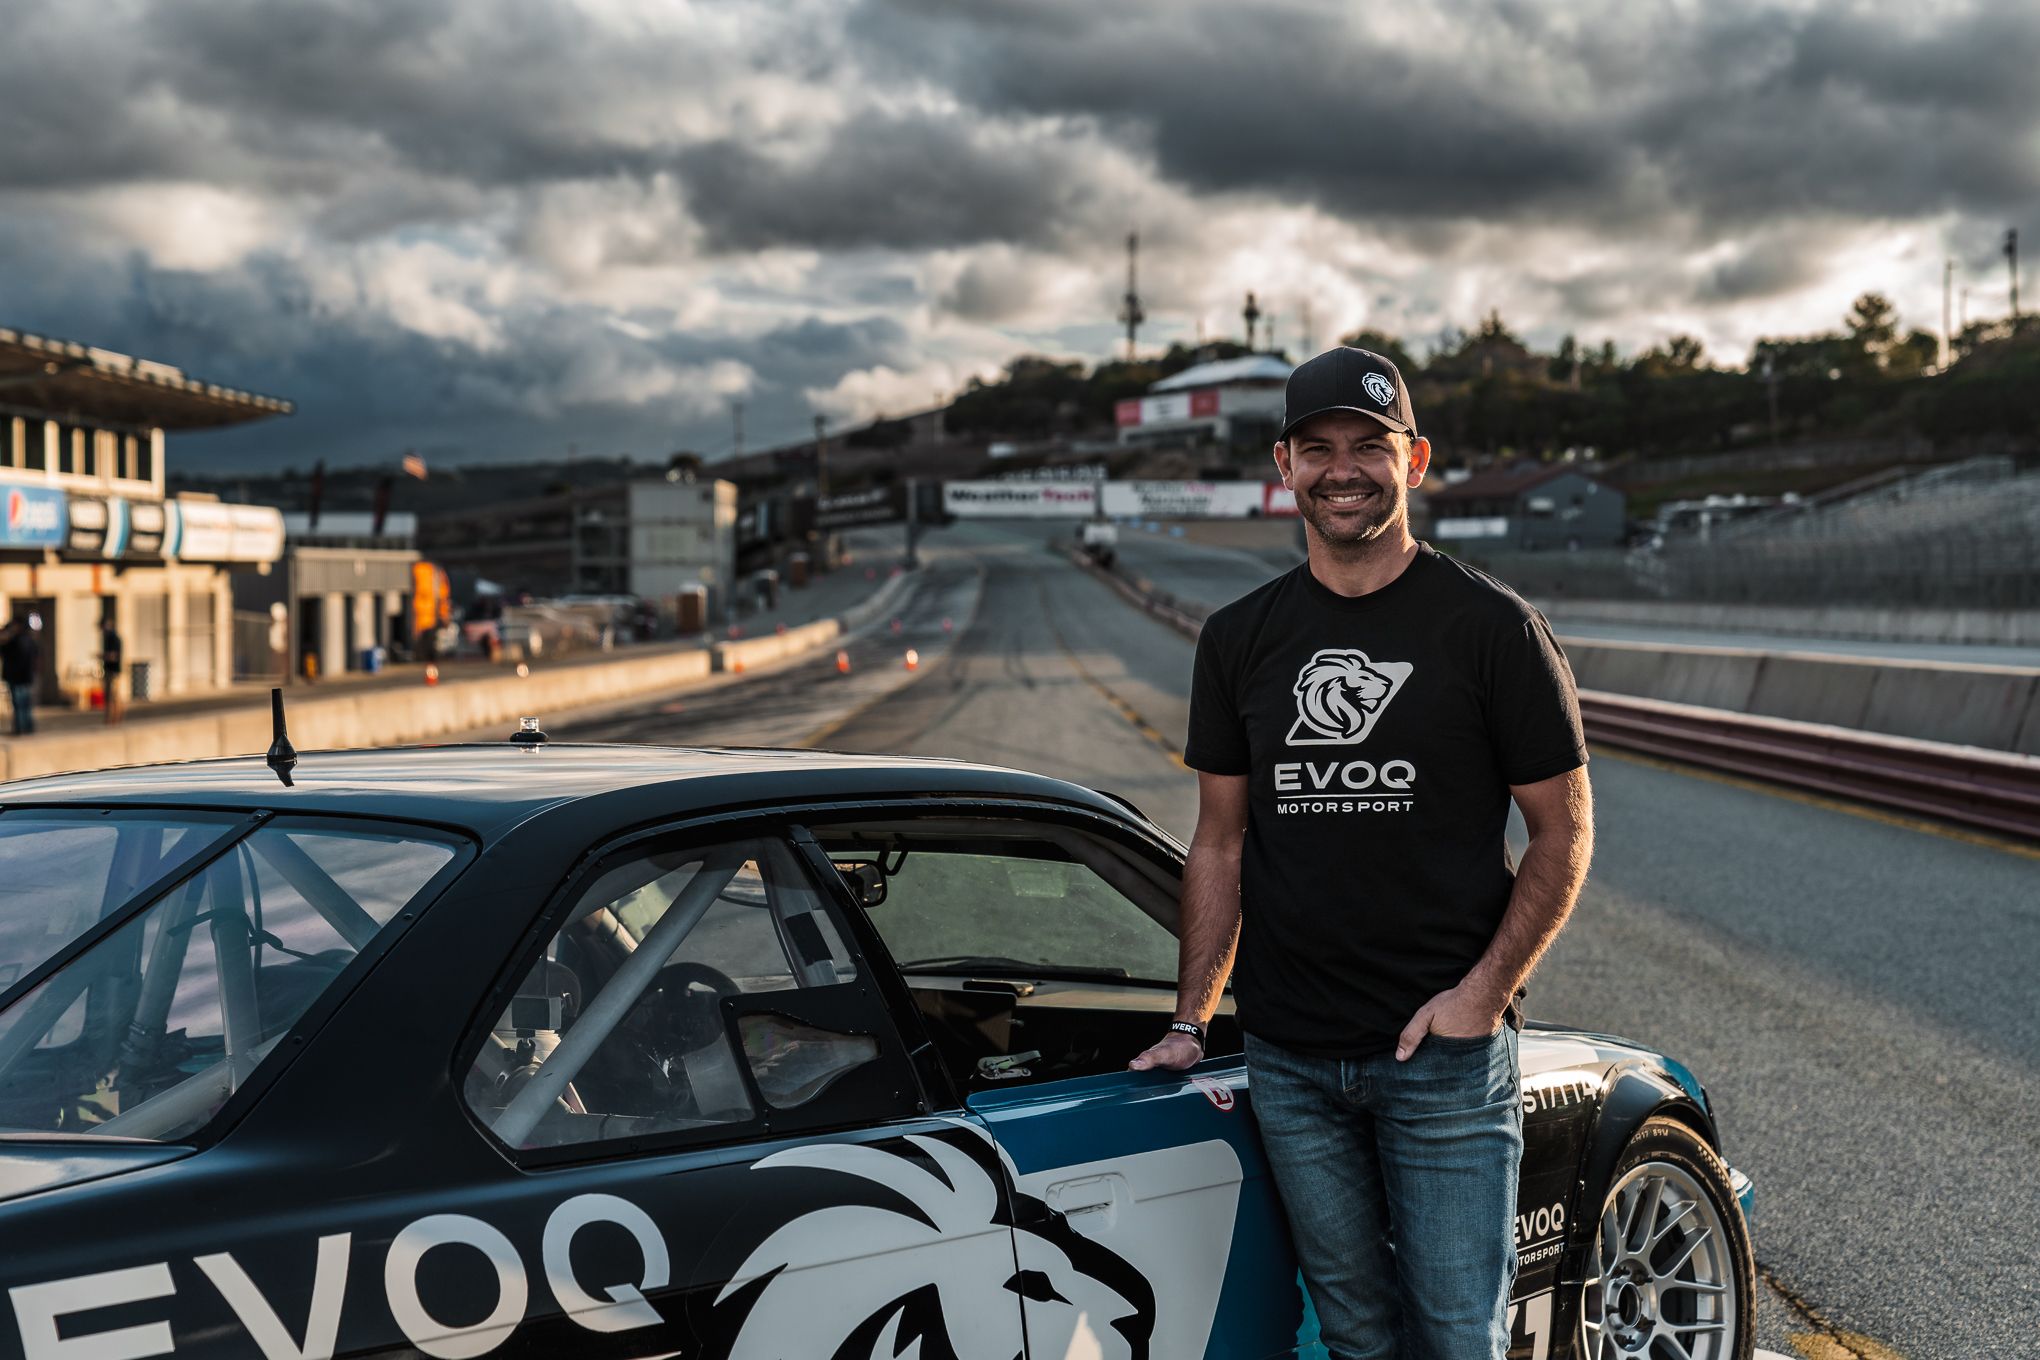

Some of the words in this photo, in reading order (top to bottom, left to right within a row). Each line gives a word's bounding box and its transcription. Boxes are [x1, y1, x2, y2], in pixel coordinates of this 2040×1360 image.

[1275, 760, 1416, 790] EVOQ
[1278, 801, 1414, 814] MOTORSPORT
[1172, 1022, 1198, 1035] WERC
[1518, 1242, 1565, 1267] TORSPORT
[8, 1193, 670, 1360] EVOQ
